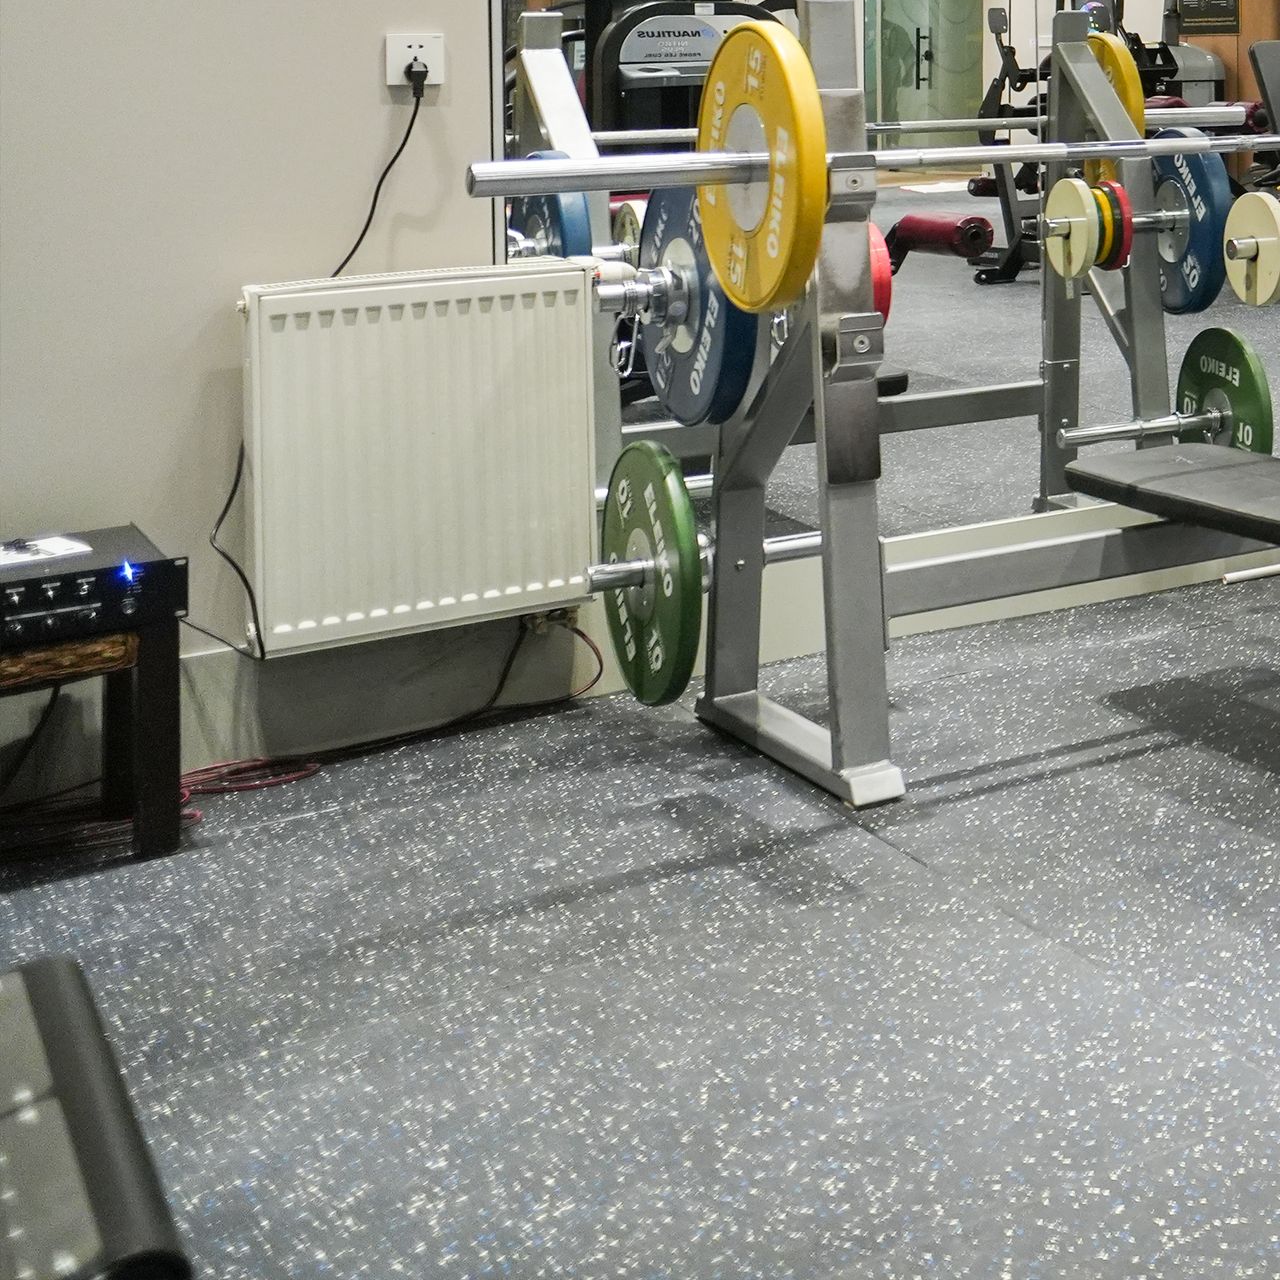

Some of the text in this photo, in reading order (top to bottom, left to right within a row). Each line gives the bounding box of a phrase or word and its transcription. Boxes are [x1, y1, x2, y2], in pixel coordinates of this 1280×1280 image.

[767, 126, 789, 259] ELEIKO
[729, 239, 746, 287] 15
[690, 289, 720, 396] ELEIKO
[643, 481, 673, 598] ELEIKO
